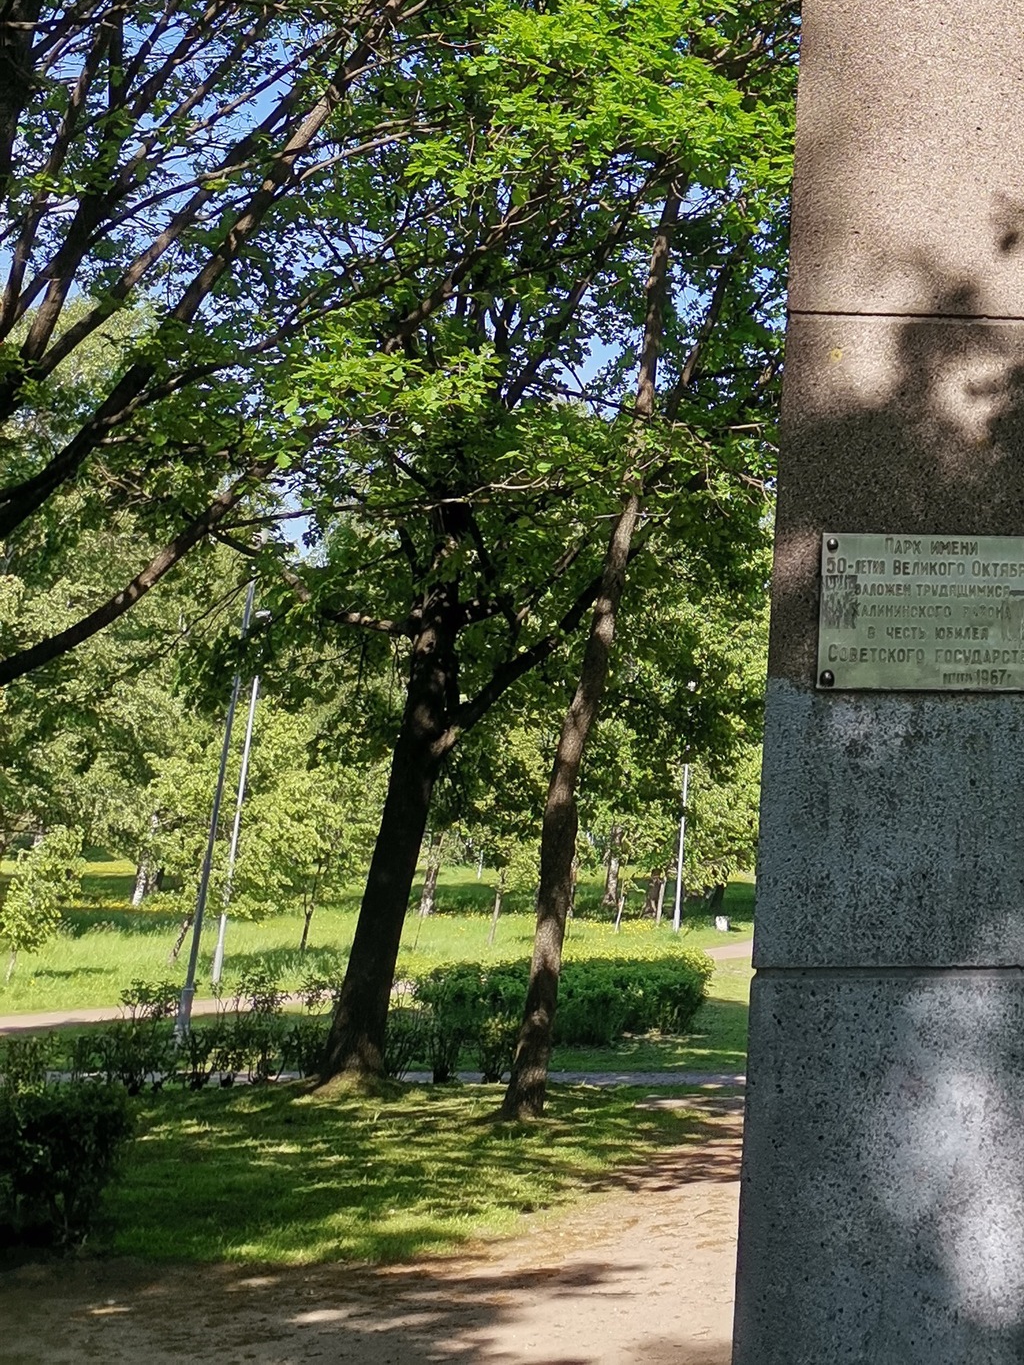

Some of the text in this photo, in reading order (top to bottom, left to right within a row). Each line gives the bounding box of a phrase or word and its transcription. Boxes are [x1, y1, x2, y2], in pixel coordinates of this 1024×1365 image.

[885, 537, 979, 556] ПАРК ИМЕНИ
[826, 557, 886, 575] 50-ЛЕТИЯ
[893, 560, 965, 576] ВЕЛИКОГО
[854, 583, 1011, 598] ЗАЛОЖЕН ТРУДЯЩИМИСЯ
[850, 600, 952, 619] КАЛИНИНСКОГО
[867, 626, 989, 641] В ЧЕСТЬ ЮБИЛЕЯ
[828, 643, 926, 664] СОВЕТСКОГО
